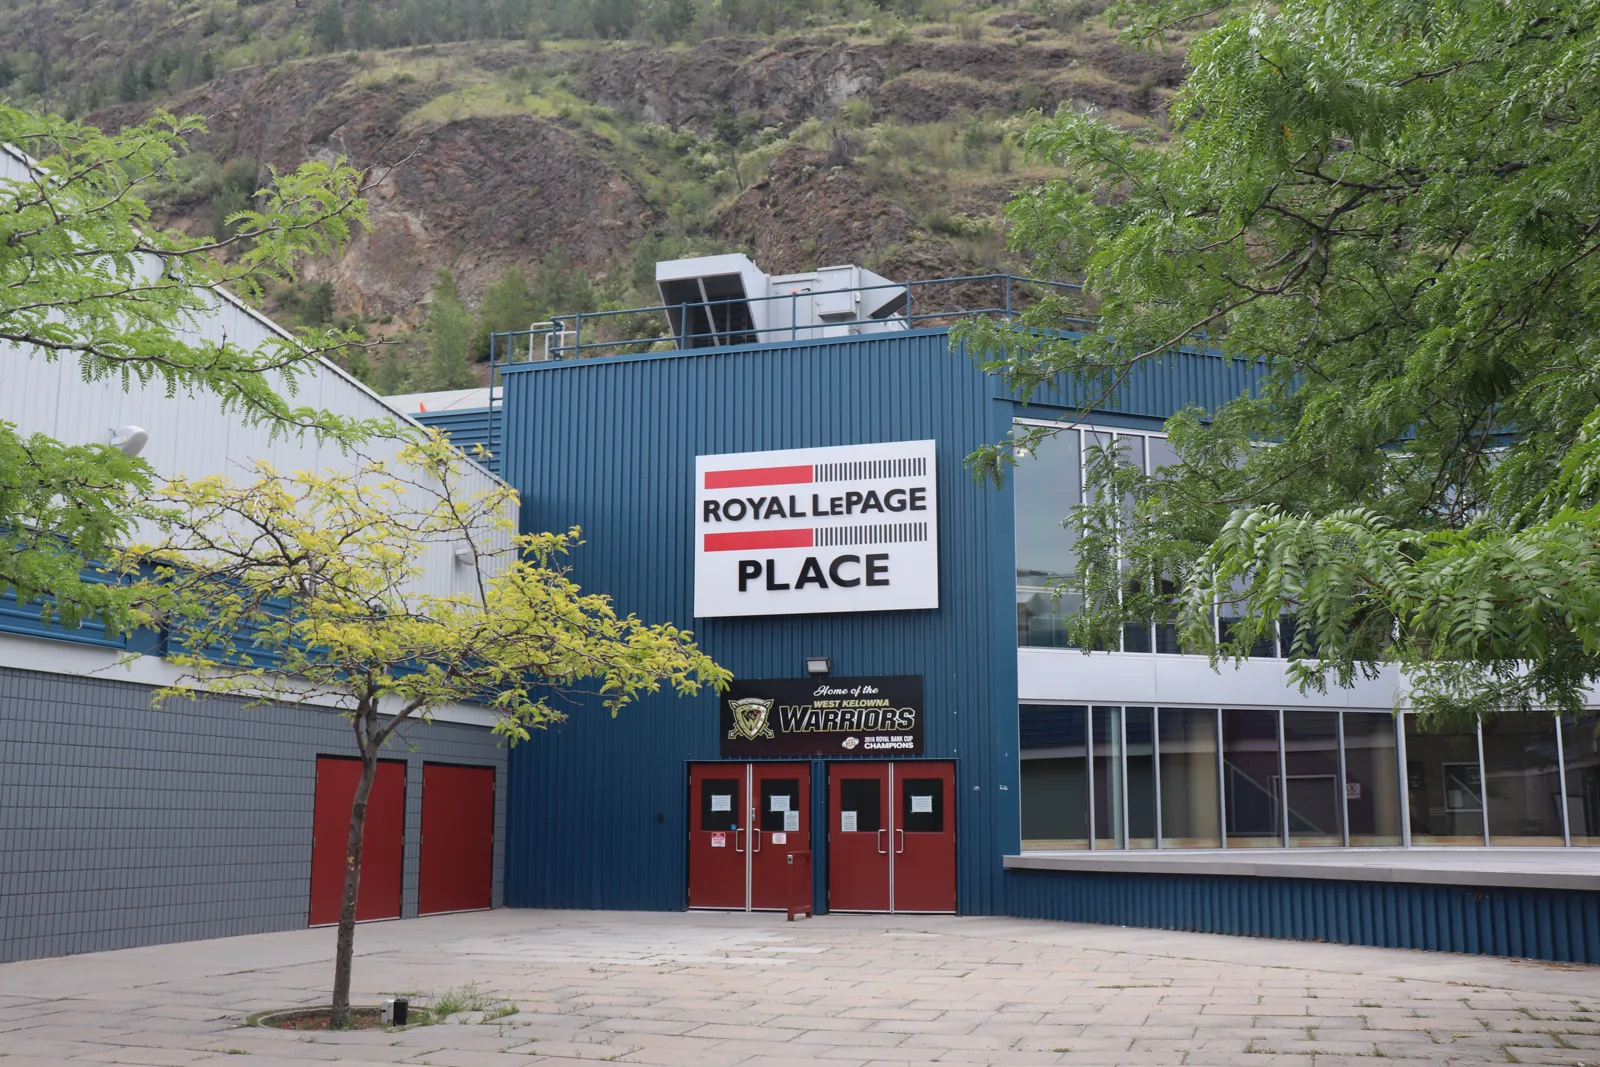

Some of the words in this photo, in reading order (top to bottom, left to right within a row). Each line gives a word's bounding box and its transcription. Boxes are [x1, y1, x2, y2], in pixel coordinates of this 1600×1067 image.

[703, 495, 806, 523] ROYAL
[738, 553, 890, 592] PLACE
[813, 685, 848, 697] Home
[850, 685, 861, 697] of
[862, 685, 879, 694] the
[813, 700, 841, 708] WEST
[842, 699, 890, 708] KELOWNA
[778, 705, 916, 733] WARRIORS
